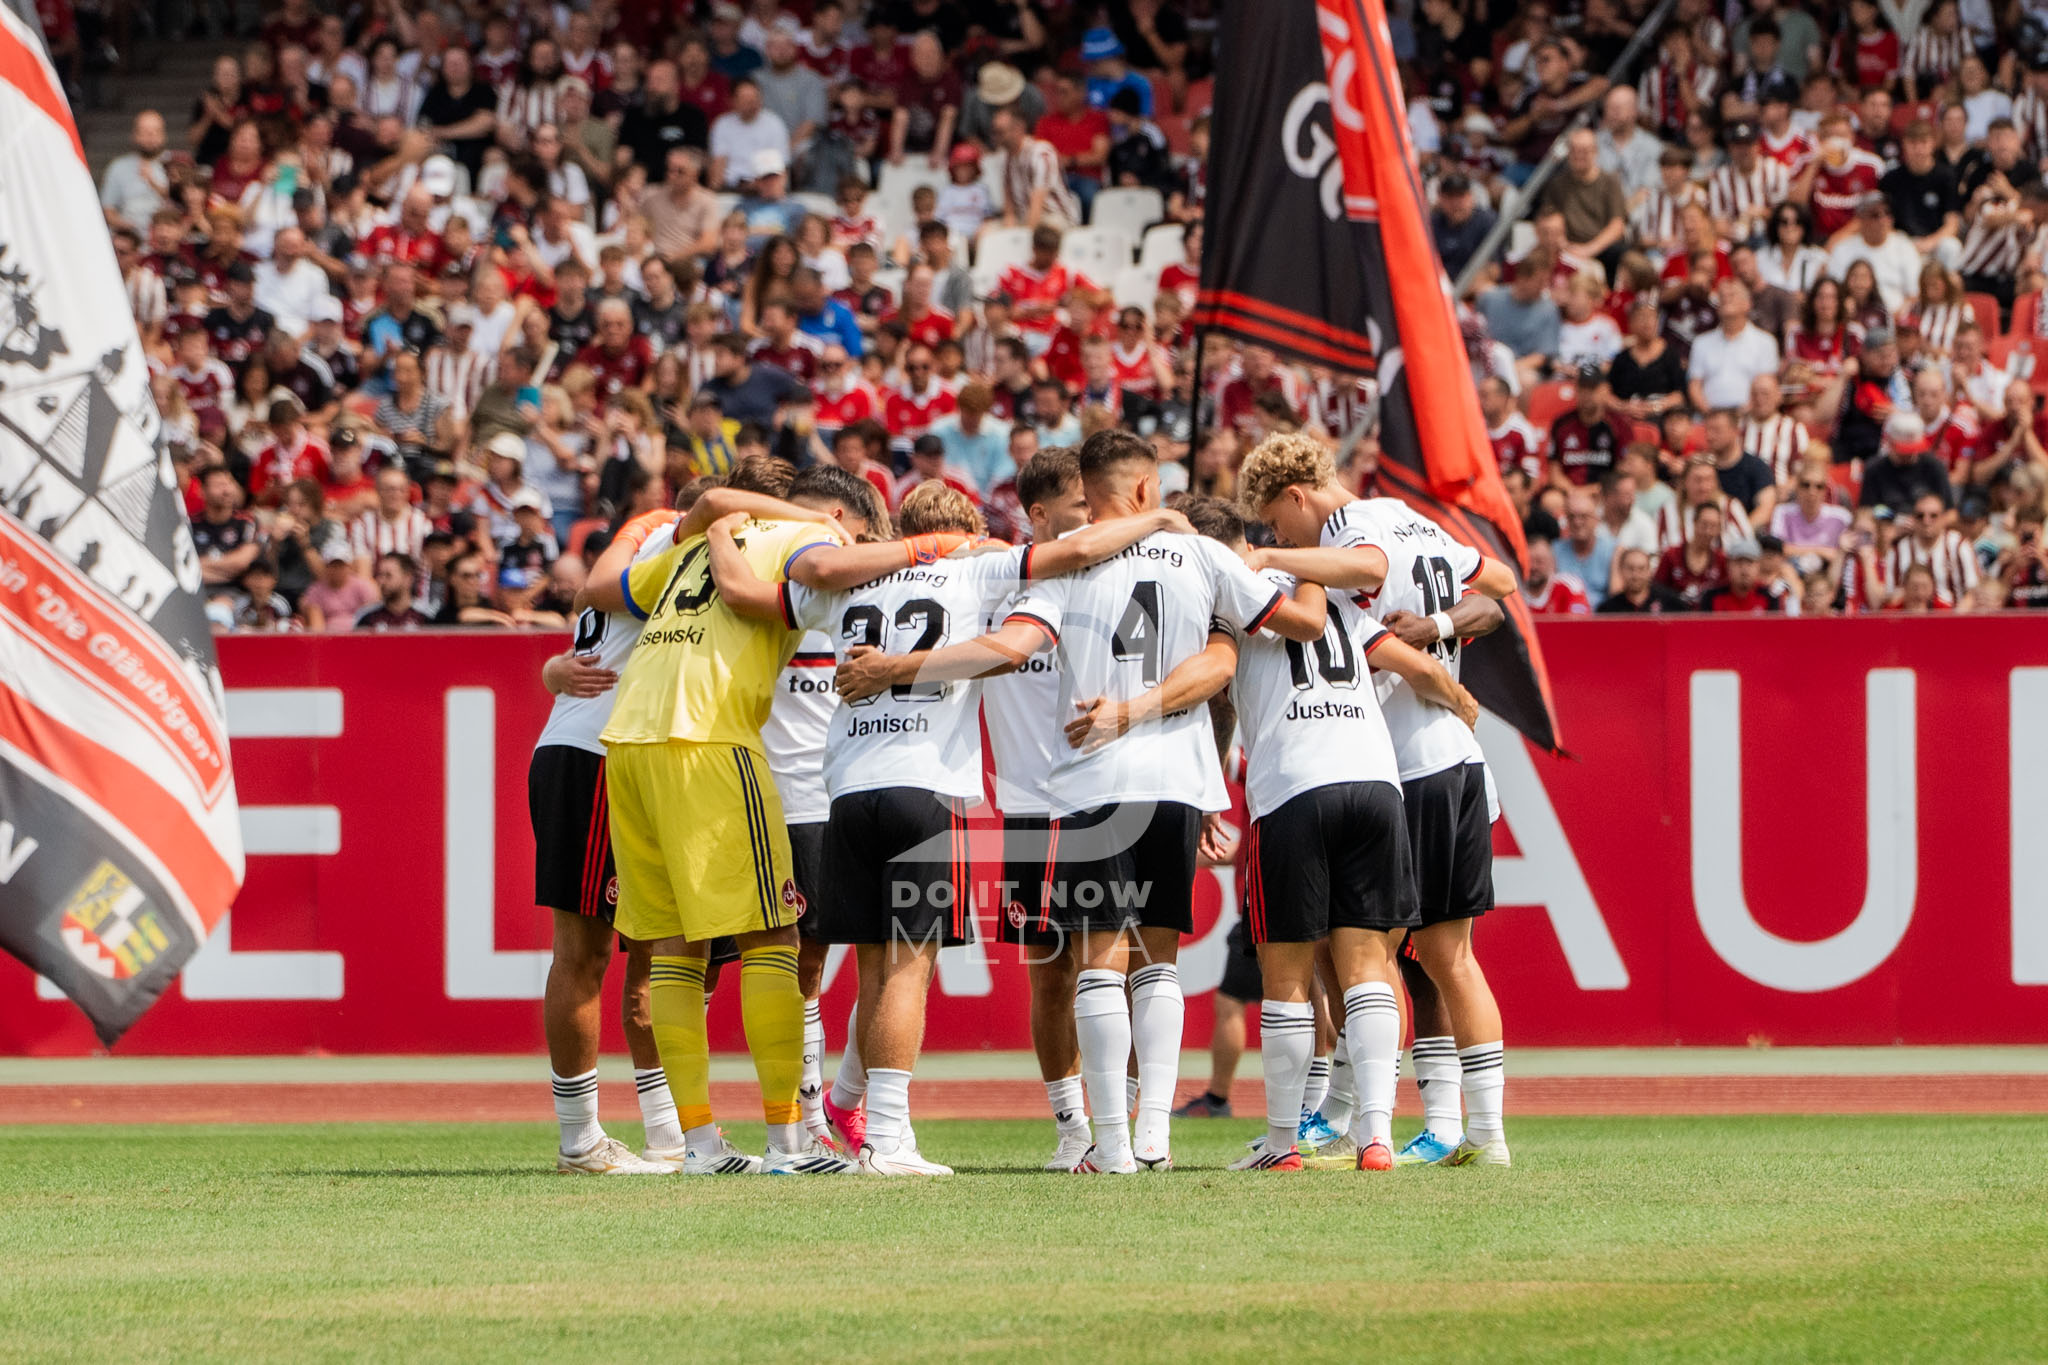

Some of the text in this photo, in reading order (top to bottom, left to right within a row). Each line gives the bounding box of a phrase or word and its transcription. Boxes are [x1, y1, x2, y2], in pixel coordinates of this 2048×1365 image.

[634, 625, 706, 649] isewski
[1111, 580, 1165, 688] 4
[1286, 700, 1366, 721] Justvan
[847, 713, 929, 738] Janisch
[803, 1053, 819, 1065] CN
